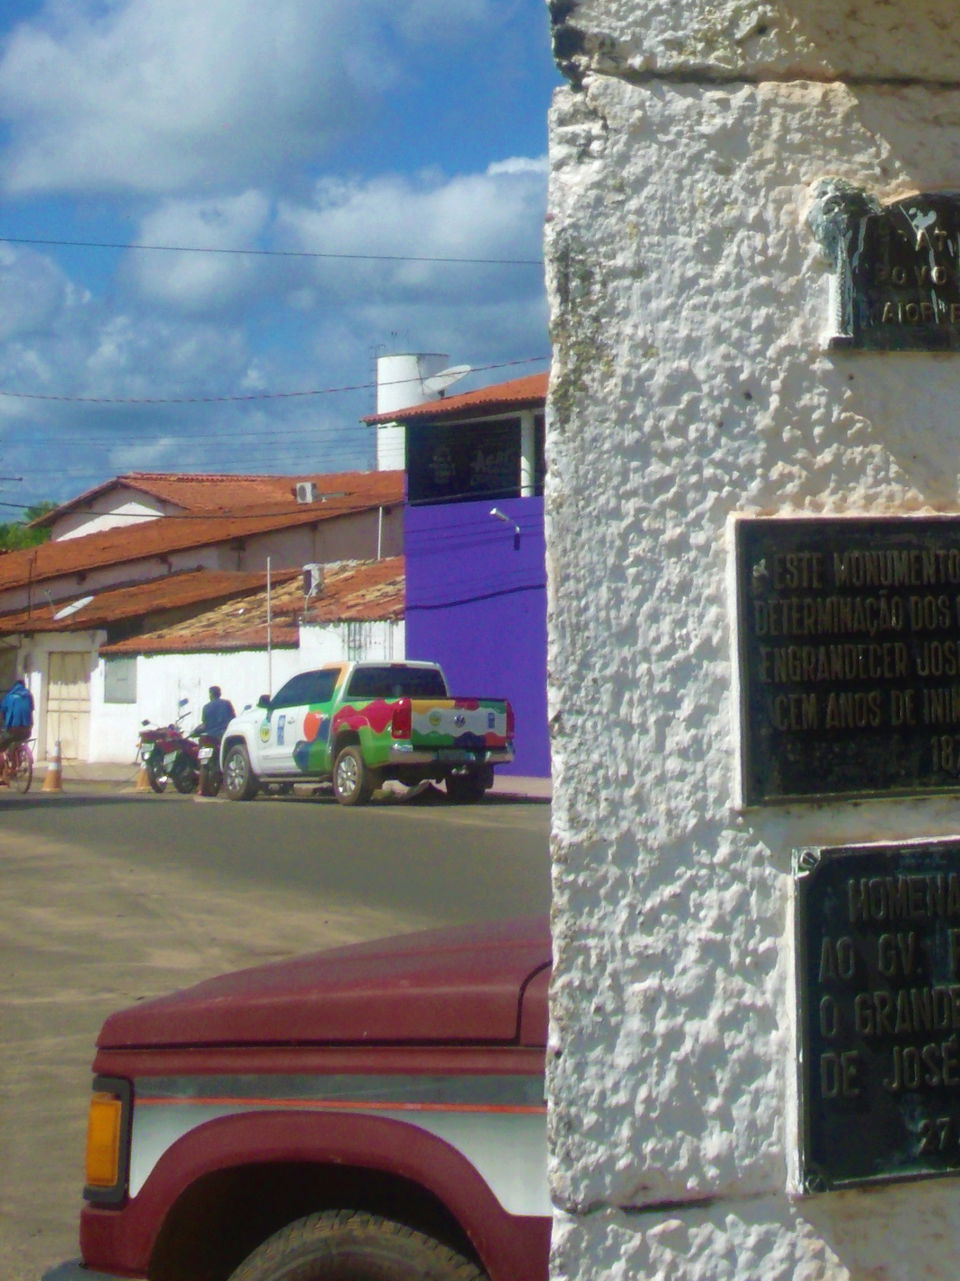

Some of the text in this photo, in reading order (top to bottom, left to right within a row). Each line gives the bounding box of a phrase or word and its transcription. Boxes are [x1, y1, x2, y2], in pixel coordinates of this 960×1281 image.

[773, 552, 824, 590] ESTE
[754, 589, 905, 637] DETERMINAÇÃO
[909, 594, 952, 631] DOS
[761, 642, 909, 685] ENGRANDECER
[774, 693, 819, 731] CEM
[825, 691, 882, 728] ANOS
[890, 688, 917, 726] DE
[818, 934, 857, 985] AO
[818, 993, 841, 1040] O
[818, 1049, 862, 1100] DE
